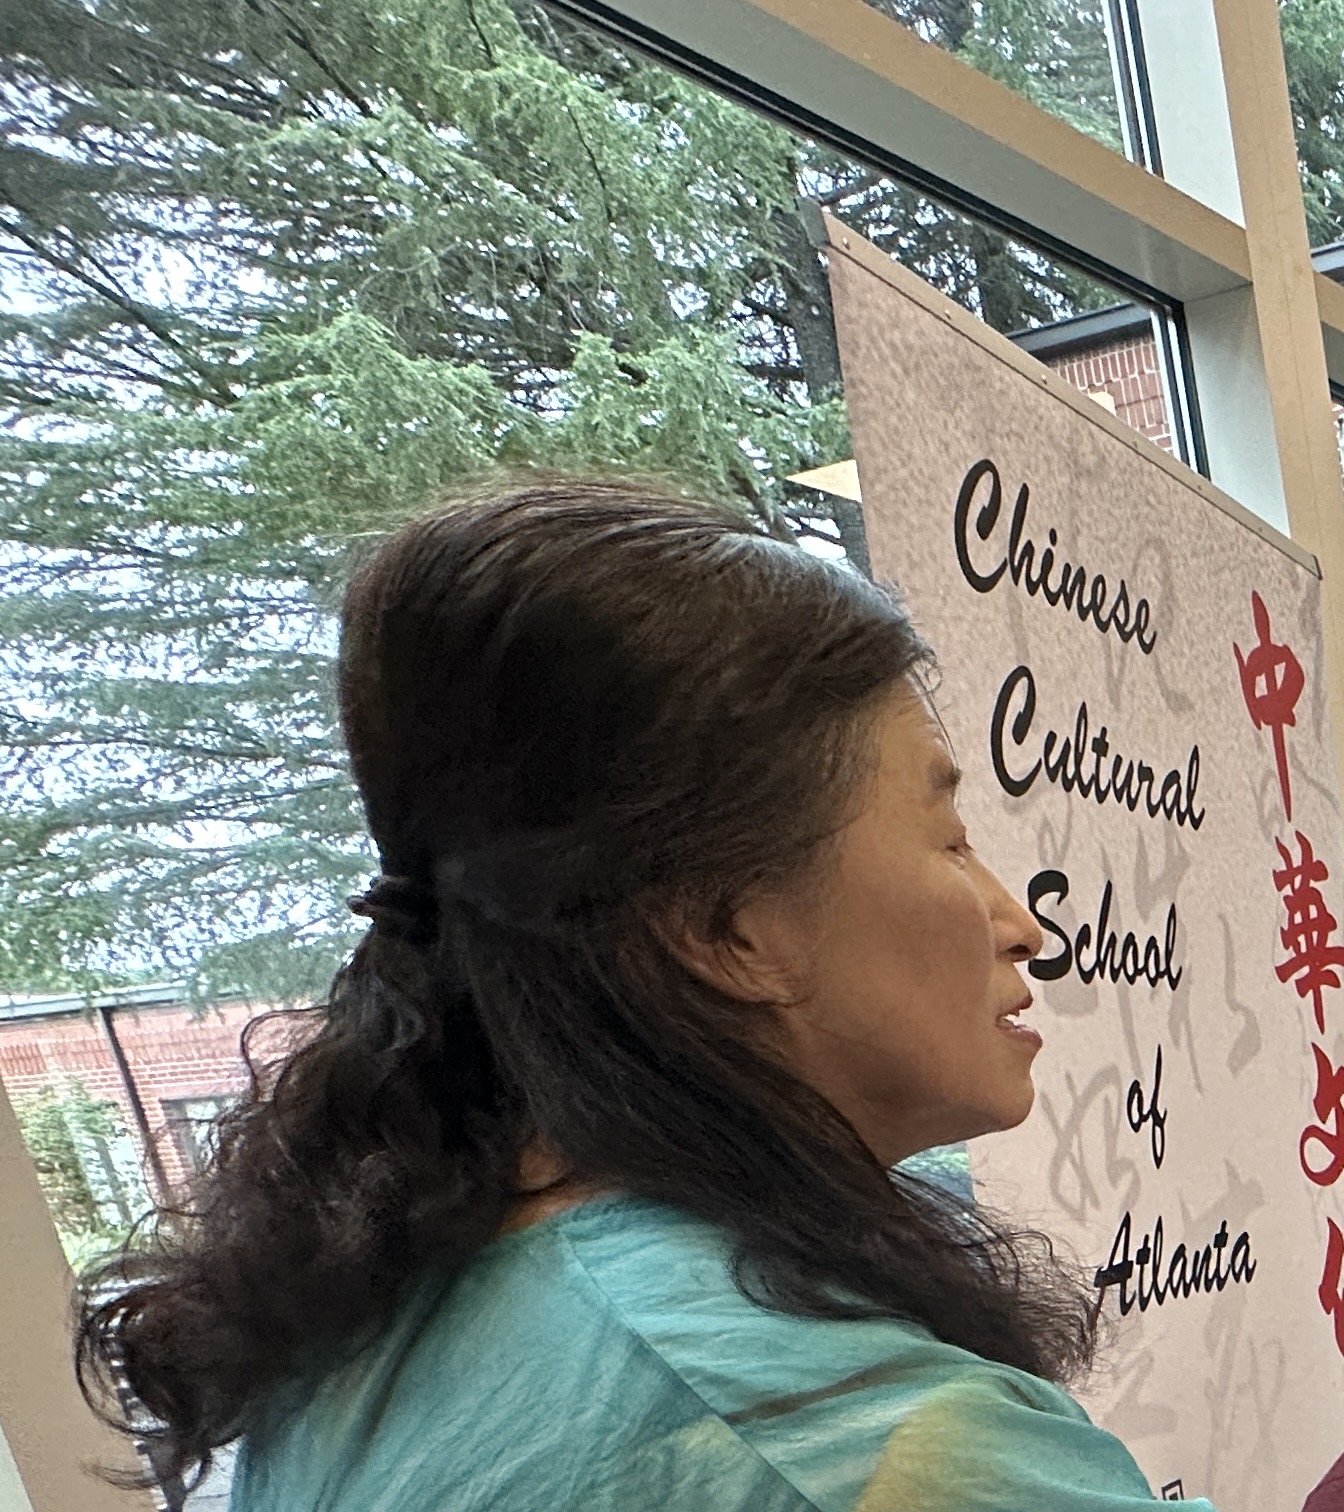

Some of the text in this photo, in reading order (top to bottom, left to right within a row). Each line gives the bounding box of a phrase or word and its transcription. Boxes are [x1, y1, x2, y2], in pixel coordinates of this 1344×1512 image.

[953, 458, 1157, 654] Chinese
[990, 664, 1206, 831] Cultural
[1026, 869, 1182, 991] School
[1126, 1043, 1168, 1170] of
[1093, 1211, 1257, 1318] Atlanta
